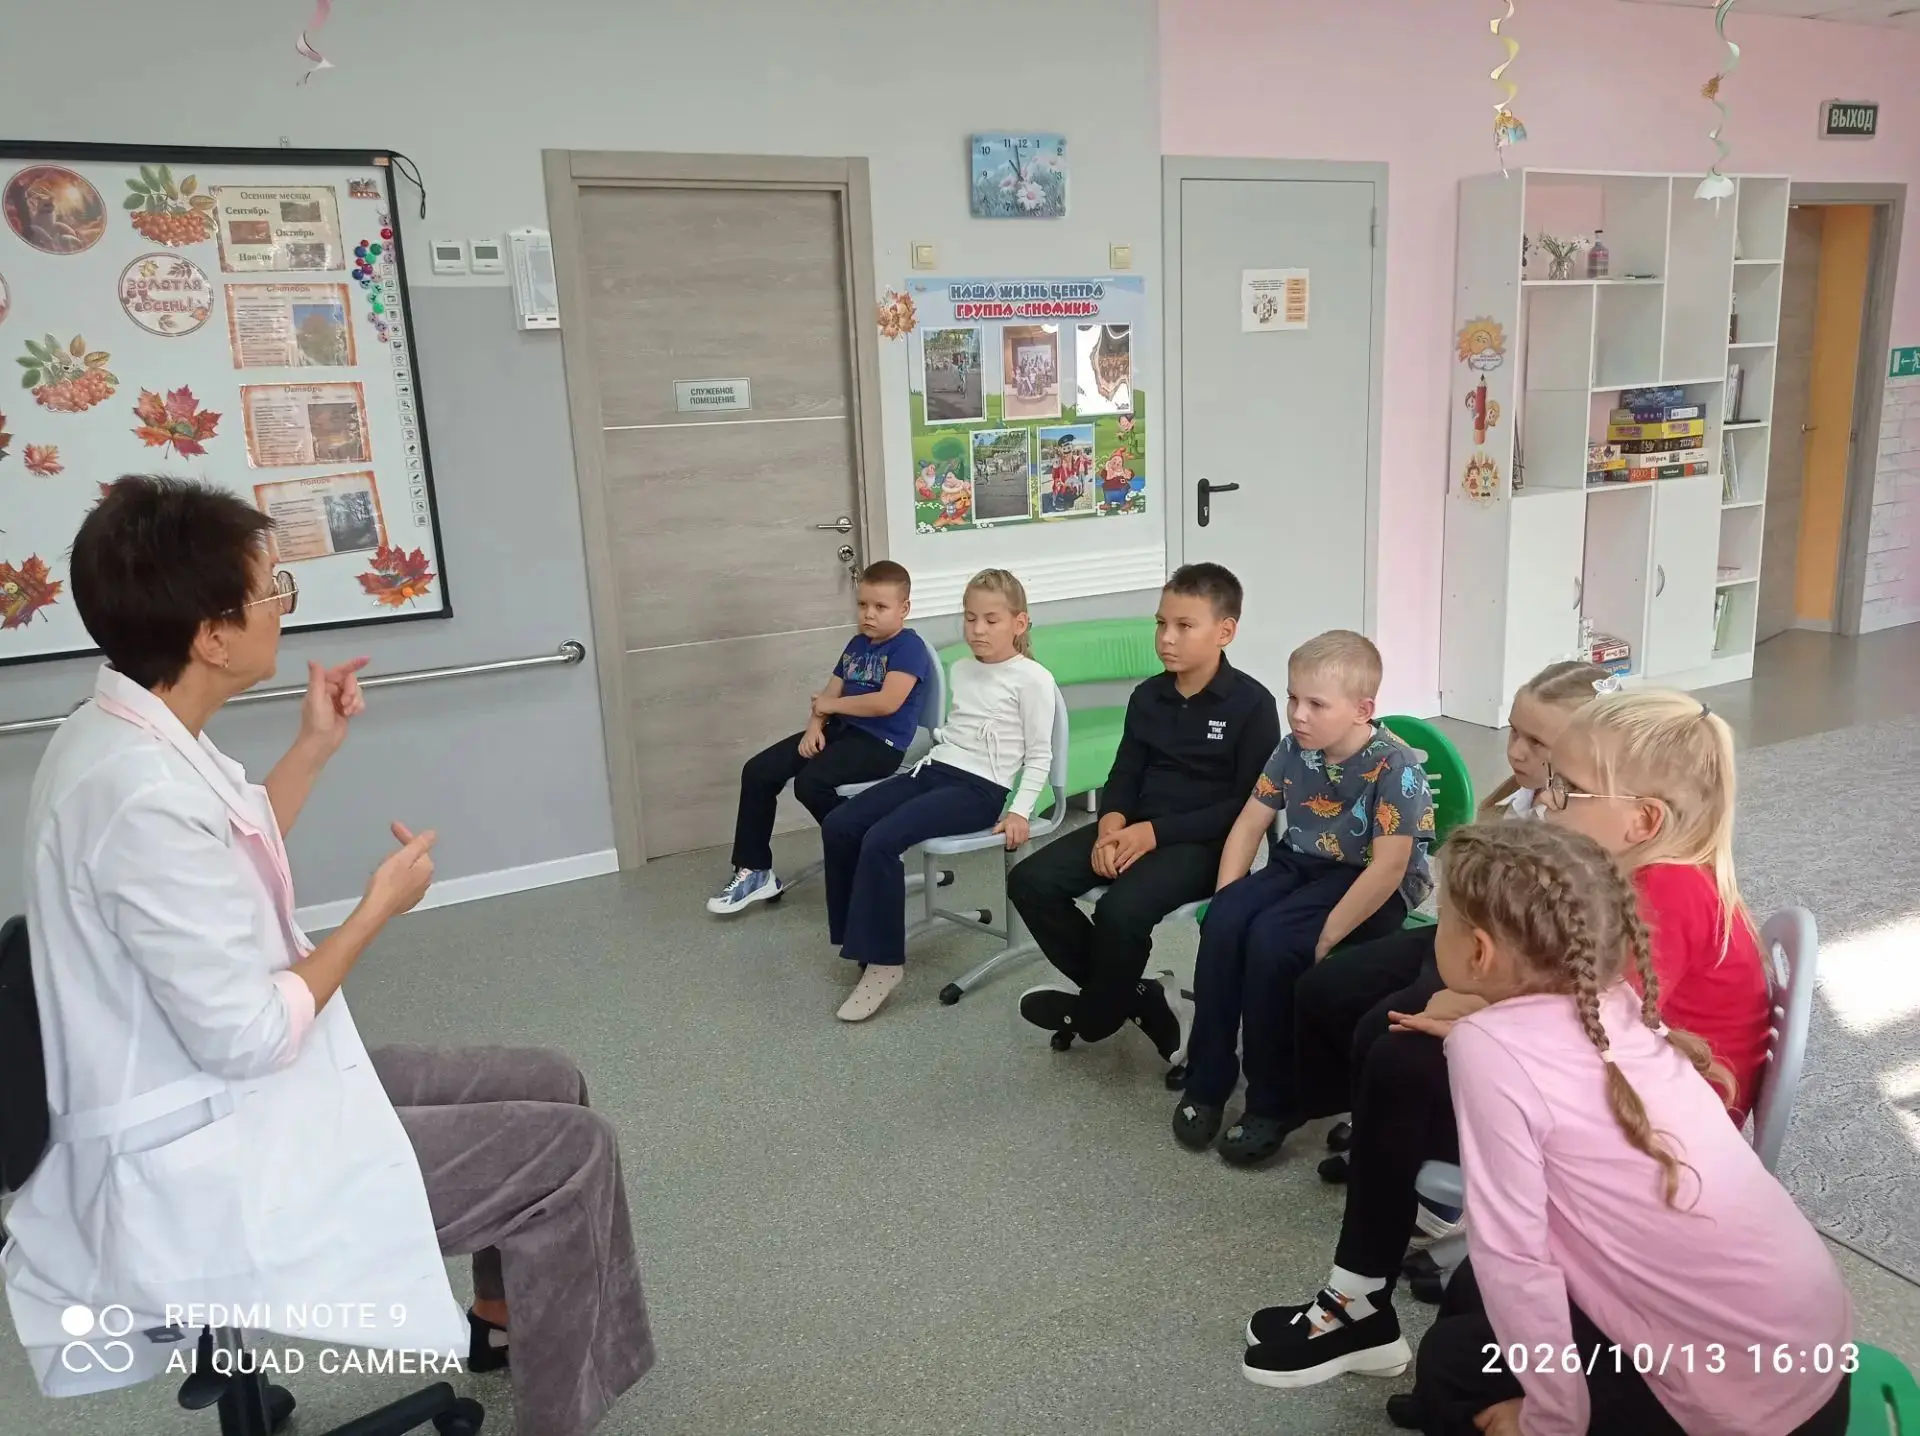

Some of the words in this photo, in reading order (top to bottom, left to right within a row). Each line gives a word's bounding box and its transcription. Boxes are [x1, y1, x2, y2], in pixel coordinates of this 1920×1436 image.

[1830, 108, 1874, 131] ВЫХОД
[1004, 138, 1011, 148] 11
[1018, 139, 1028, 148] 12
[981, 146, 990, 155] 10
[240, 191, 277, 200] Осенние
[279, 191, 311, 200] месяцы
[225, 206, 270, 215] Сентябрь
[275, 228, 314, 238] Октябрь
[127, 279, 203, 292] ЗОЛОТАЯ
[951, 283, 996, 299] НАША
[999, 283, 1049, 299] ЖИЗНЬ
[1050, 283, 1104, 300] ЦЕНТРА
[143, 297, 194, 313] ОСЕНЬ!
[956, 303, 1013, 318] ГРУППА
[1016, 301, 1099, 316] «ГНОМИКИ»
[690, 386, 735, 396] СЛУЖЕБНОЕ
[689, 396, 736, 405] ПОМЕЩЕНИЕ
